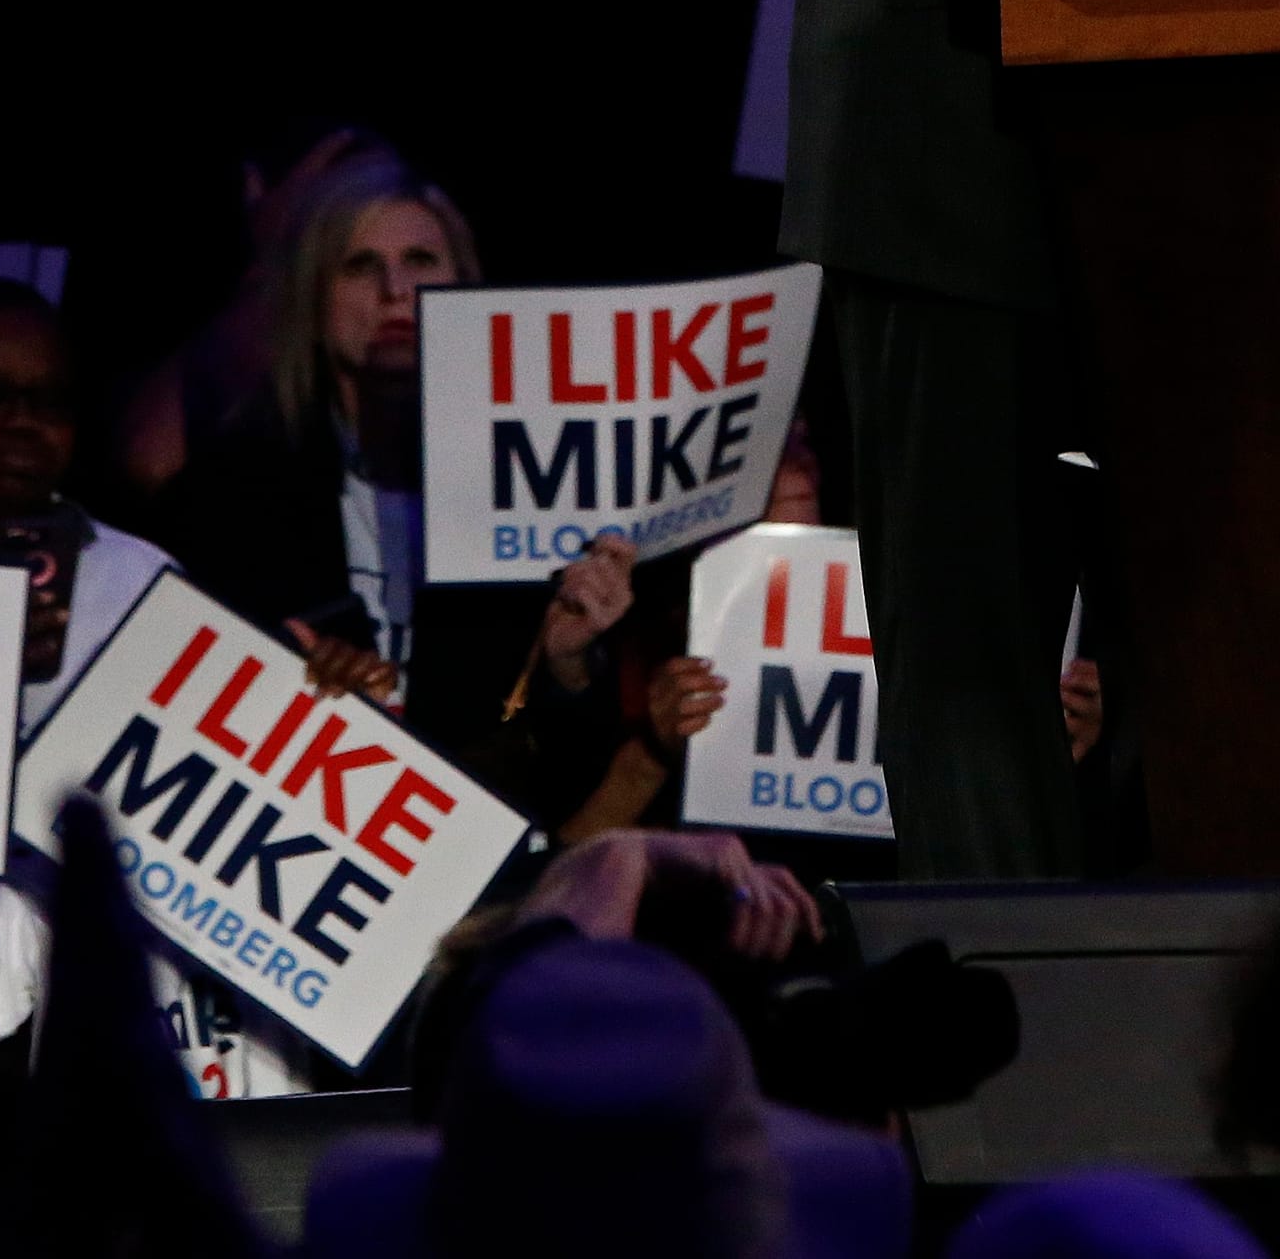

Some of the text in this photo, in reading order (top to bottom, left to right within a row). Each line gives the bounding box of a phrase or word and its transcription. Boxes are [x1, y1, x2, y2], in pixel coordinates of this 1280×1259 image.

[491, 293, 775, 404] I LIKE
[493, 392, 759, 510] MIKE
[763, 552, 791, 649] I
[149, 625, 218, 708] I
[194, 655, 458, 878] LIKE
[85, 714, 394, 967] MIKE
